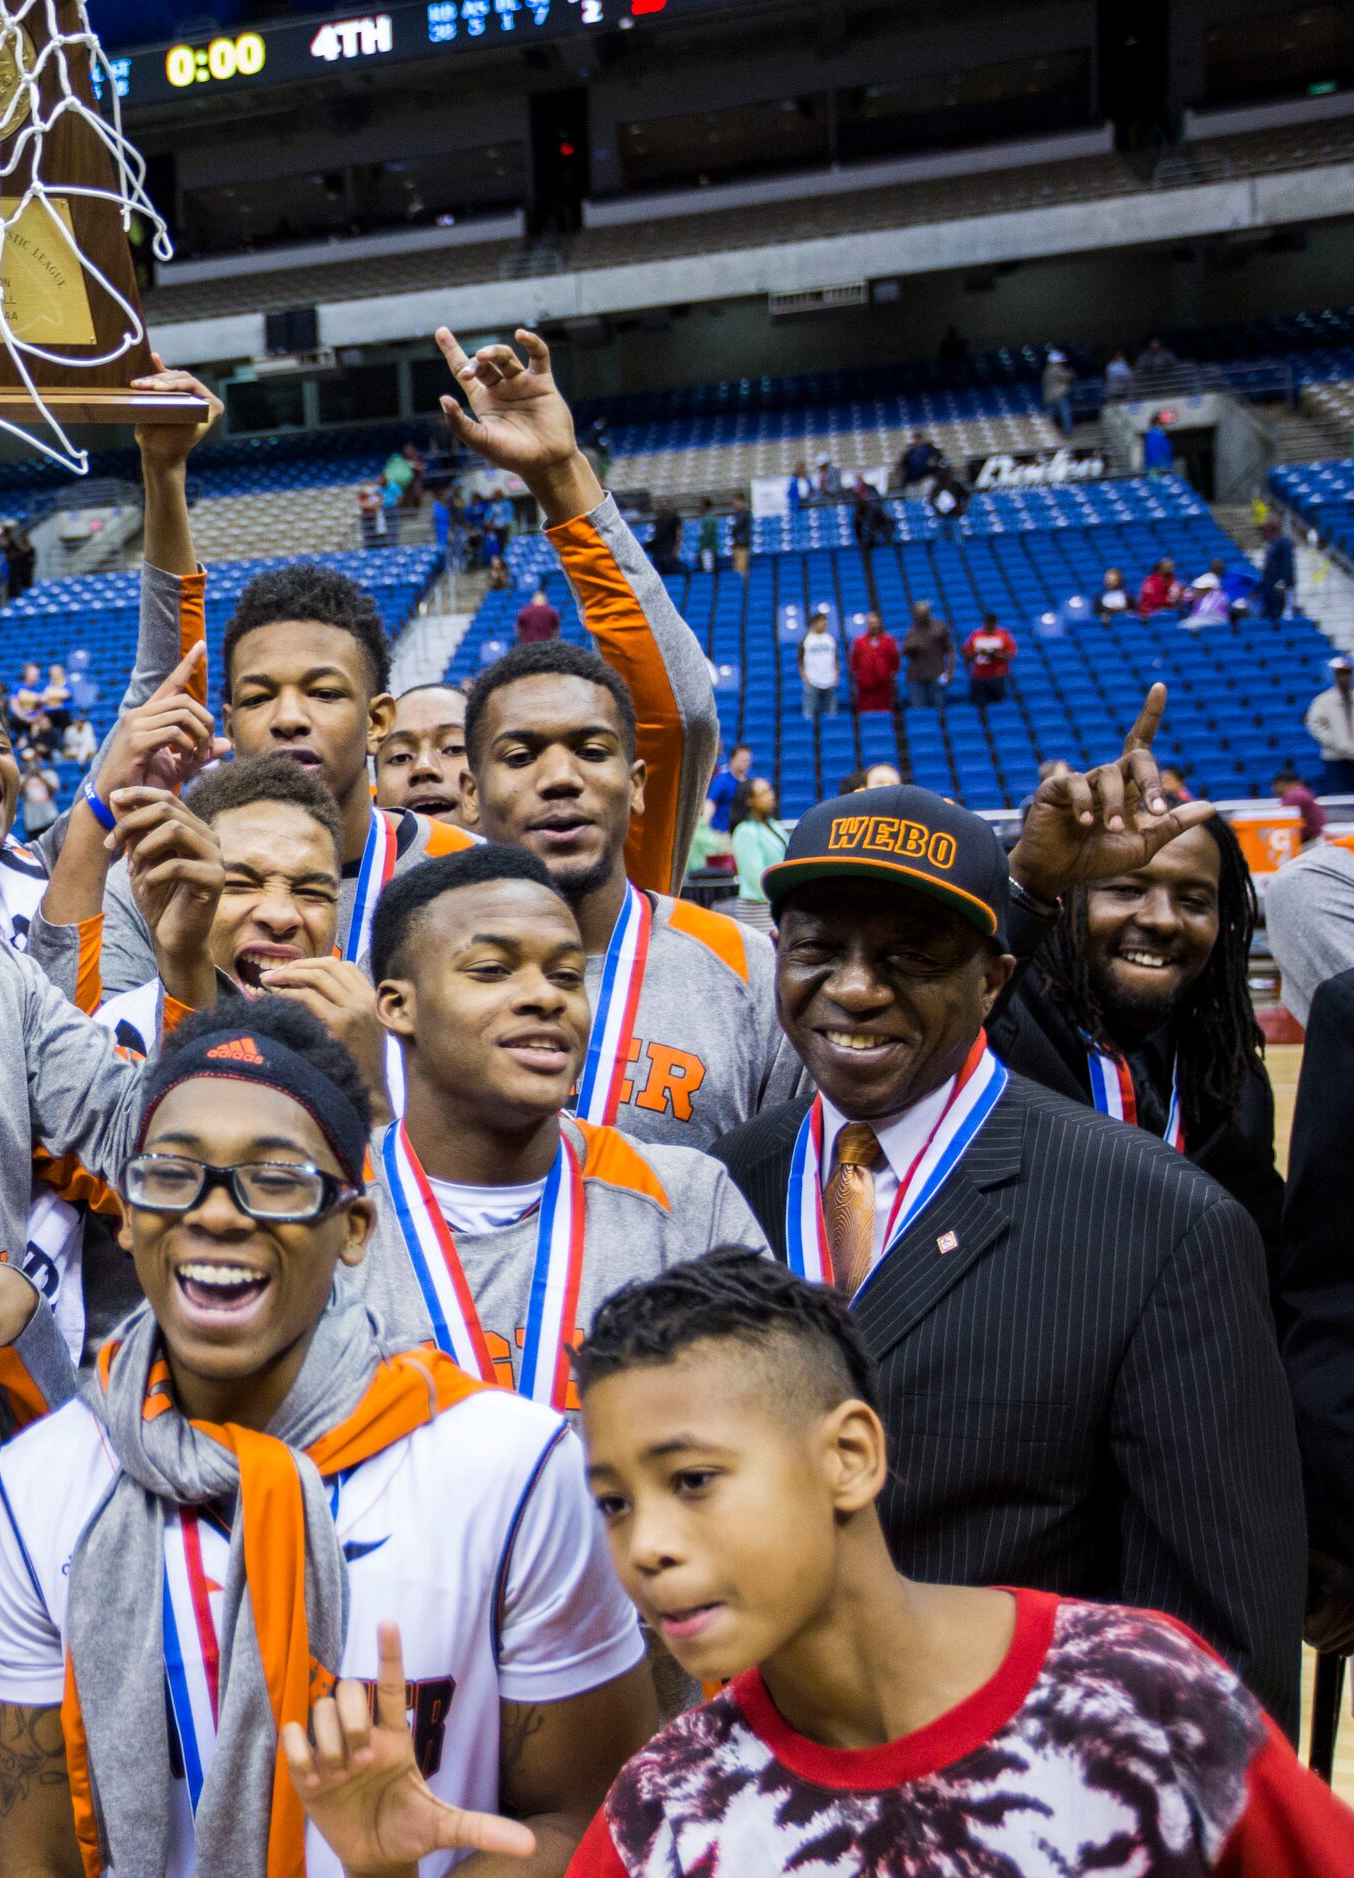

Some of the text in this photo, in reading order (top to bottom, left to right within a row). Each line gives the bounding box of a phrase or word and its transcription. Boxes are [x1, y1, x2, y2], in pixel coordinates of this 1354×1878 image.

[166, 31, 266, 88] 0:00
[311, 18, 393, 62] 4TH
[32, 248, 68, 290] LEAGUE
[828, 815, 958, 870] WEBO
